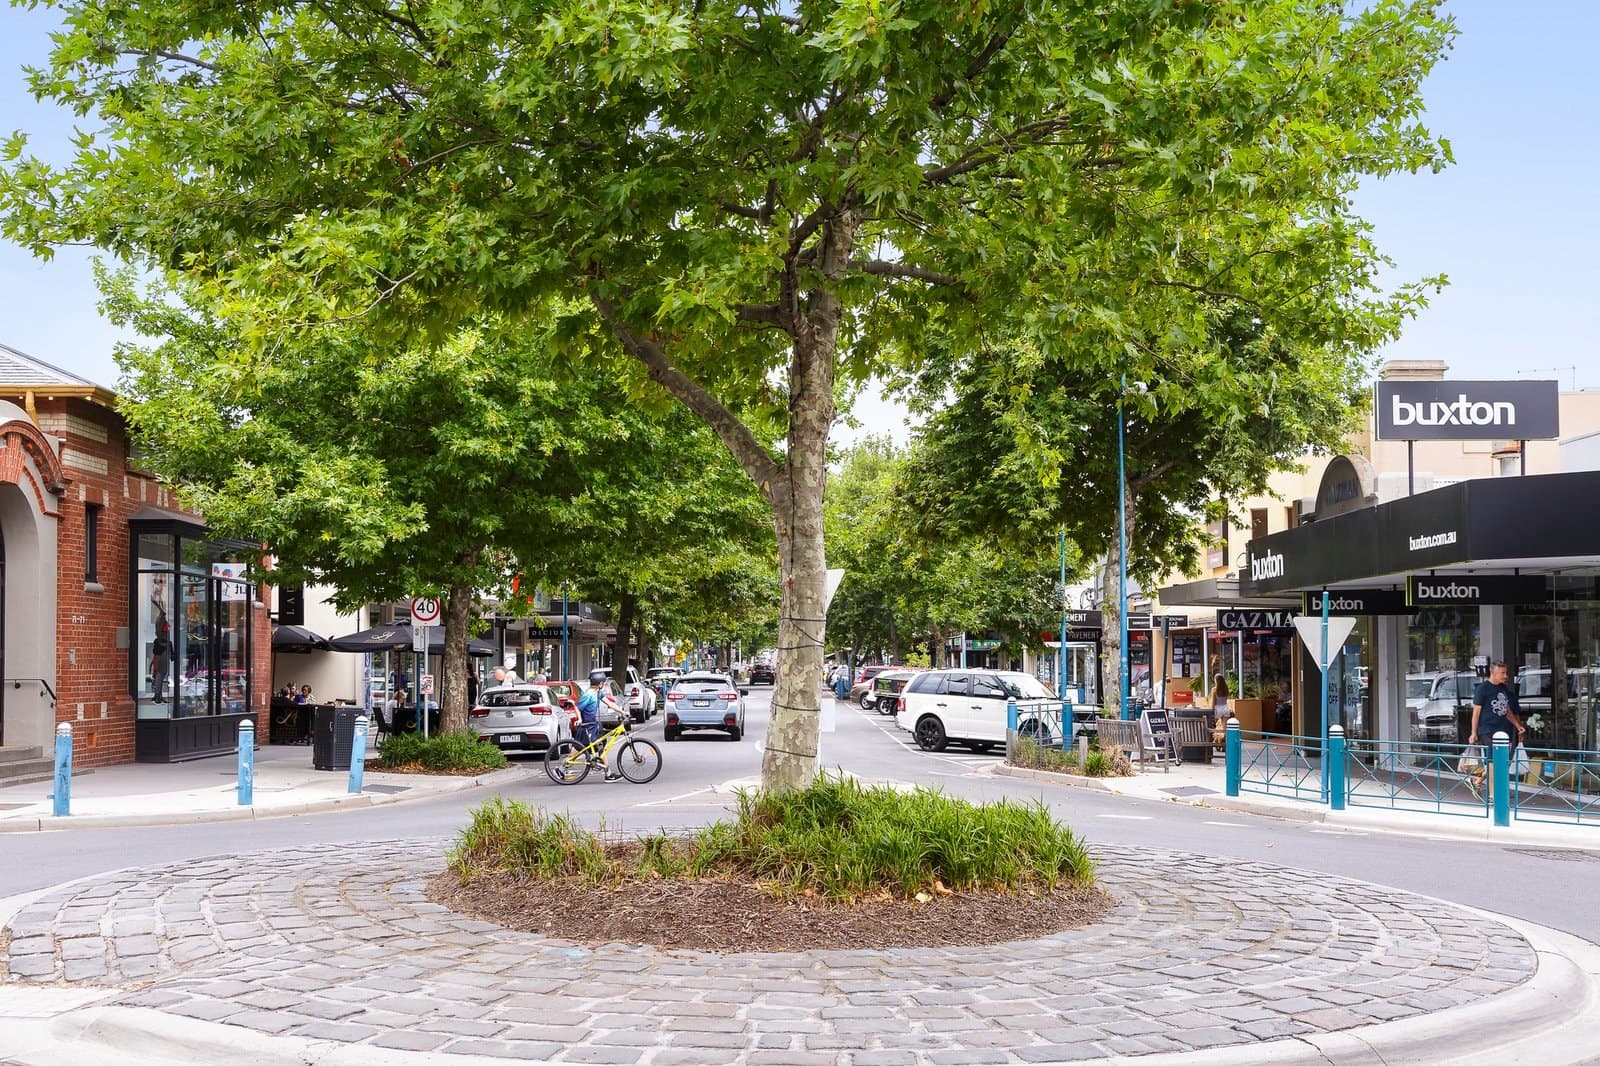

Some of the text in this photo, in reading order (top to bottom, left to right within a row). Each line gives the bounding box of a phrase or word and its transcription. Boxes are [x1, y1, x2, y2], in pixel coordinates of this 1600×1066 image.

[1392, 394, 1516, 426] buxton
[1409, 531, 1457, 551] buxton.com.au
[1251, 549, 1284, 581] buxton
[1418, 582, 1480, 599] buxton
[416, 601, 435, 614] 40
[1065, 613, 1087, 622] EMENT
[1222, 612, 1300, 628] GAZMA
